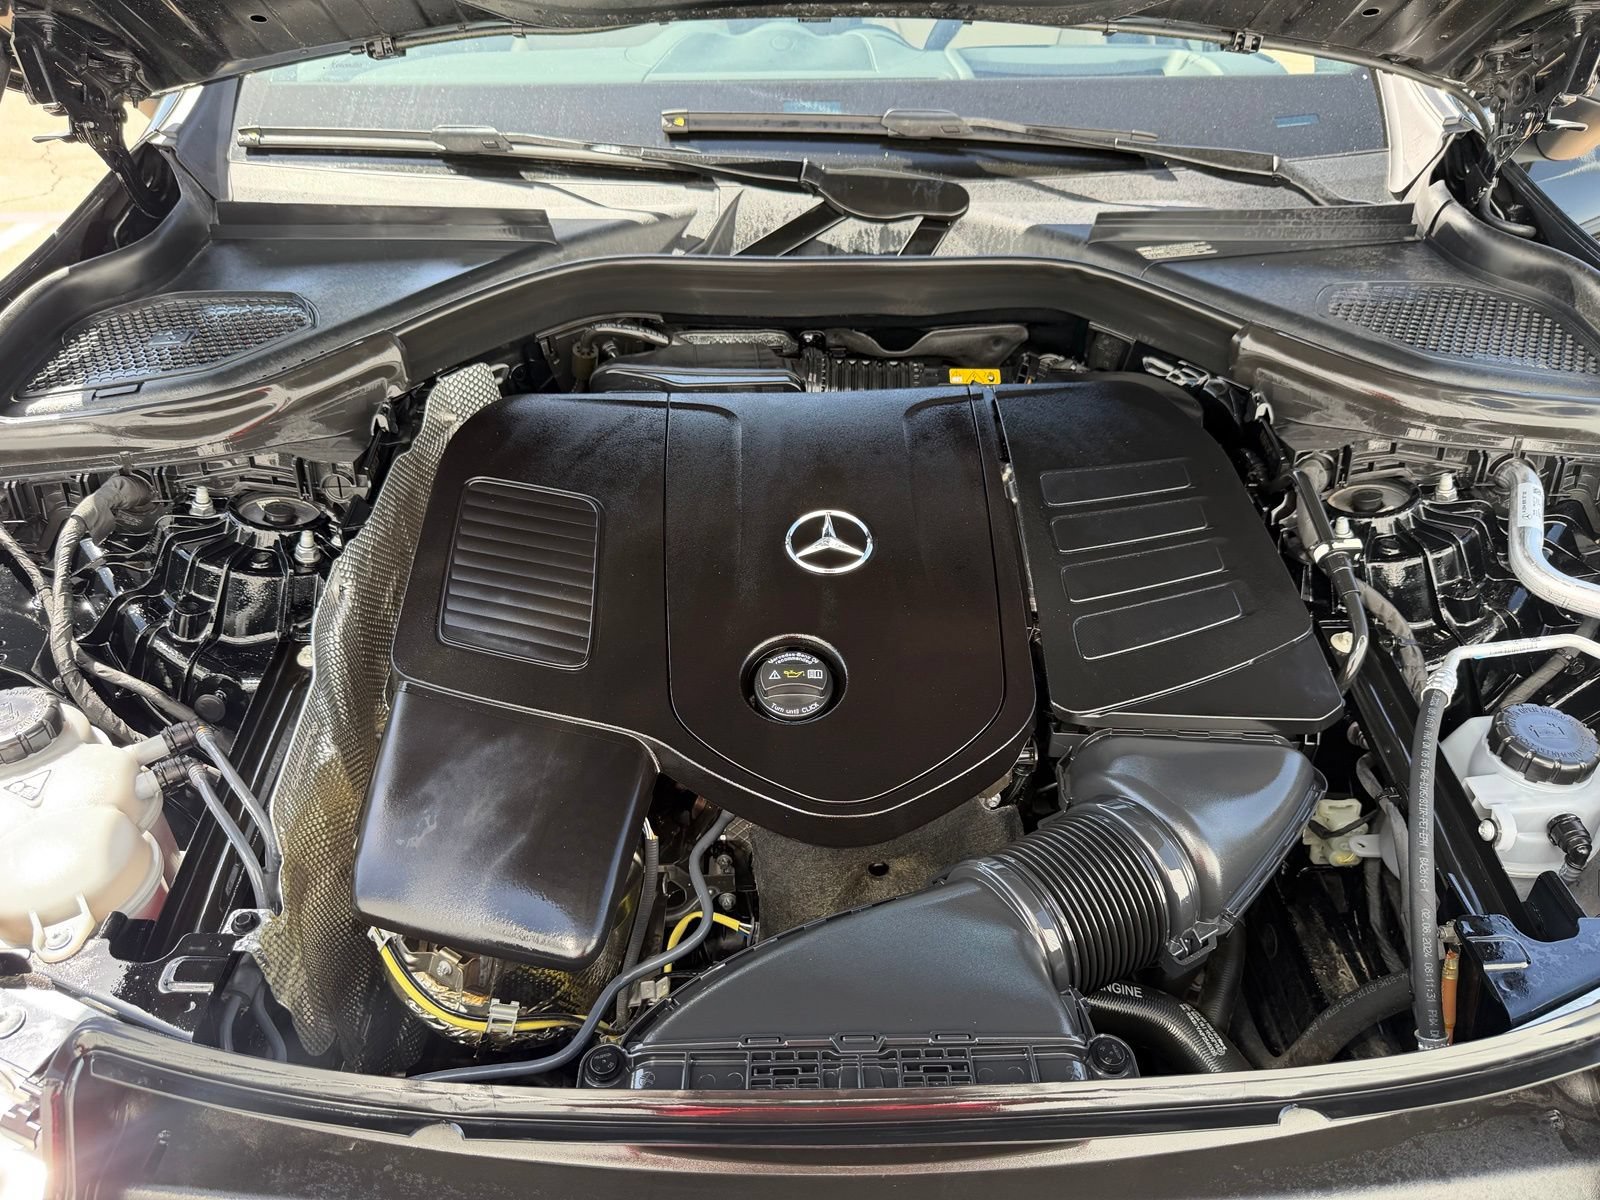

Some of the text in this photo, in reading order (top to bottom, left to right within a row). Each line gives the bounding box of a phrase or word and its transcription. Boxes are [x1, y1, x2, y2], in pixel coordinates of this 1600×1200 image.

[771, 702, 784, 713] Turn
[801, 702, 819, 713] CLICK
[1100, 982, 1143, 998] NGINE
